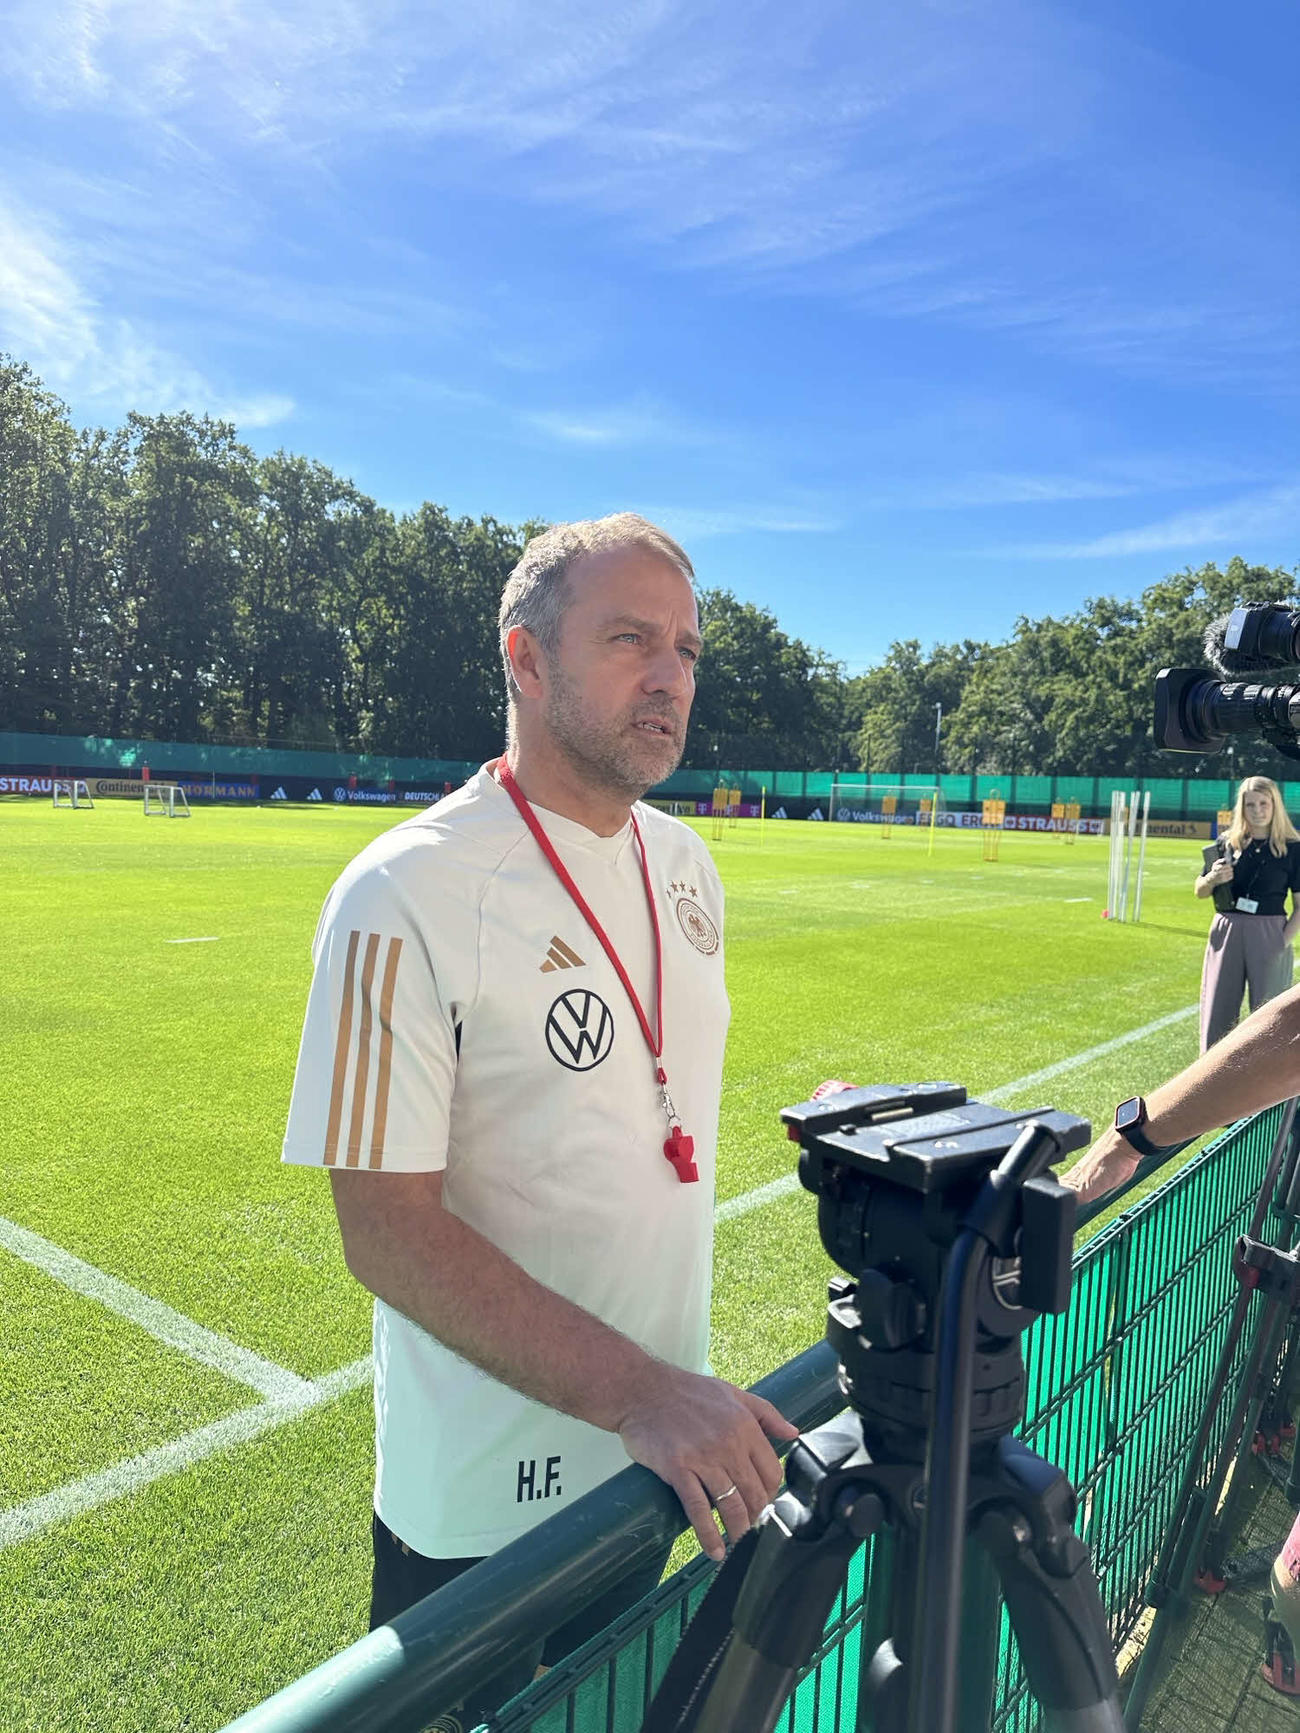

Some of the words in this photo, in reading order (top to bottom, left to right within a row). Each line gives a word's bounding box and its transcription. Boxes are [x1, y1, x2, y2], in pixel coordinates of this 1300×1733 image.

[96, 780, 164, 795] Continen
[347, 791, 396, 803] Volkswagen
[1018, 817, 1087, 832] STRAUSS
[517, 1455, 561, 1503] H.F.
